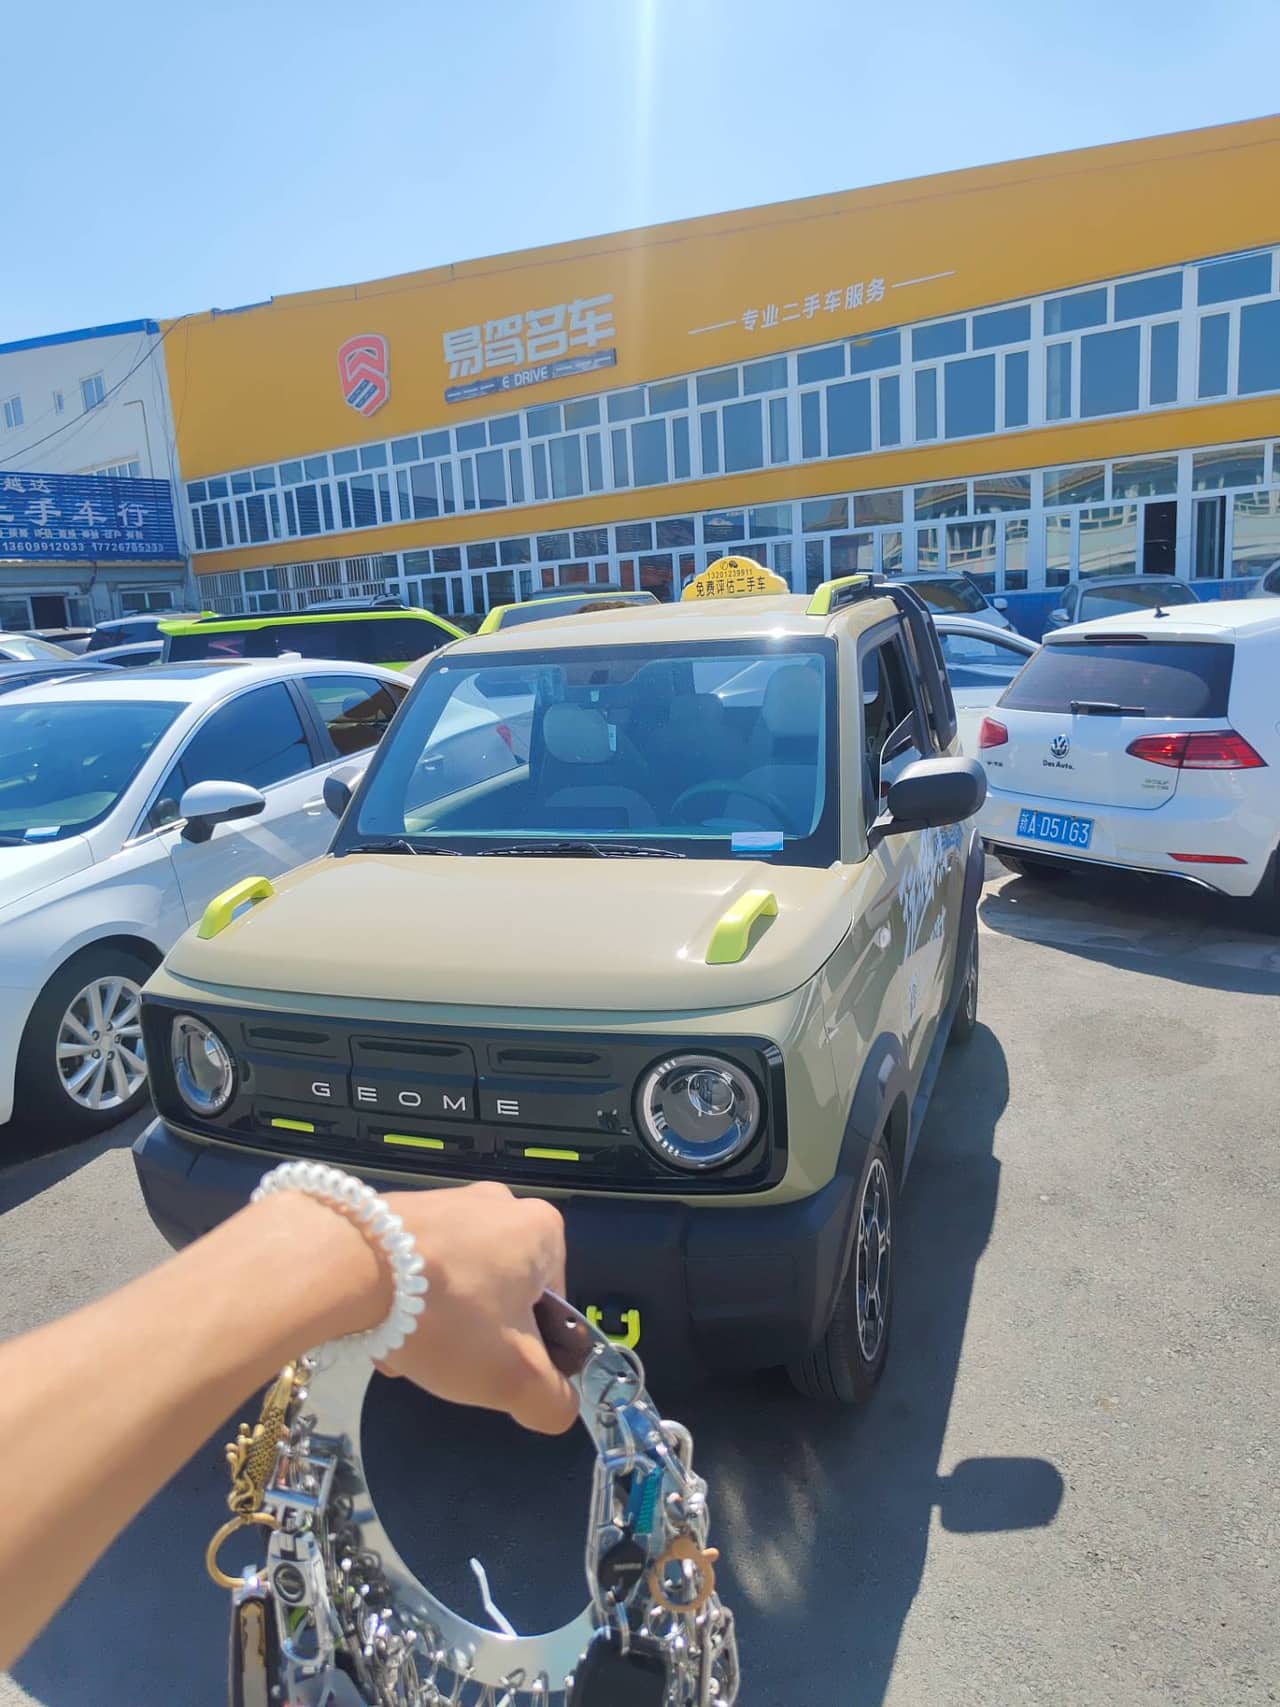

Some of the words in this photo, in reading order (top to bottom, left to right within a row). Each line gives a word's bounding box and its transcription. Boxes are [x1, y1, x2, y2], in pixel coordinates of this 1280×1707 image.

[741, 277, 886, 332] 专业二手车服务
[443, 293, 615, 380] 易驾名车
[514, 366, 548, 386] DRIVE
[696, 576, 766, 597] 免费评估二手车
[311, 1081, 519, 1116] GEOME
